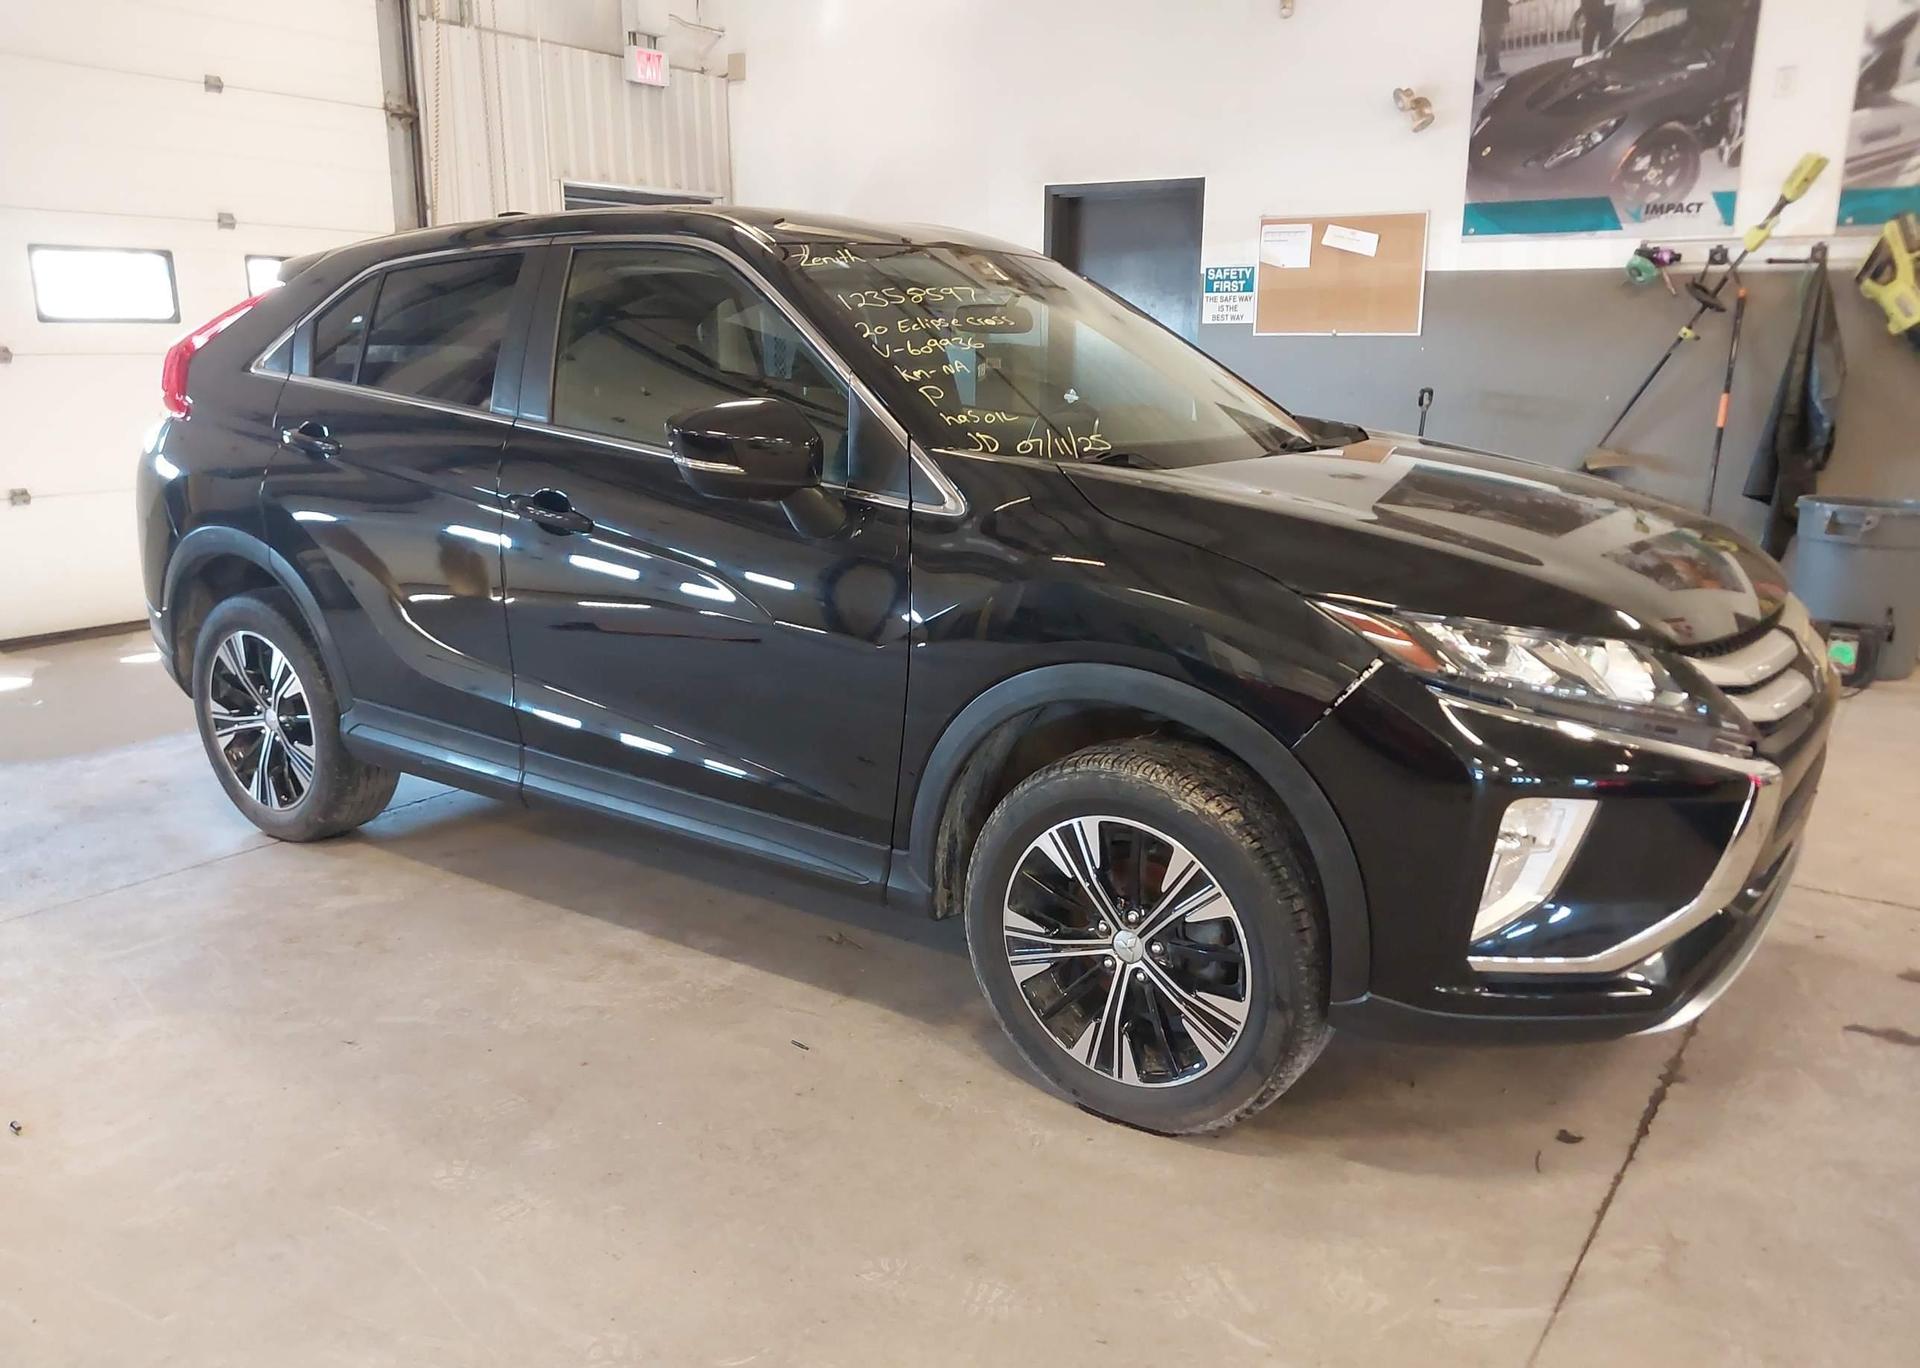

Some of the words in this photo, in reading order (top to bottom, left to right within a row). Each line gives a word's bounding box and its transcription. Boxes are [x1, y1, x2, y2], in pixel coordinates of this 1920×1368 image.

[1645, 203, 1703, 215] IMPACT
[791, 244, 867, 267] Zenith
[1207, 268, 1252, 280] SAFETY
[1213, 280, 1246, 292] FIRST
[837, 287, 976, 311] 12358597
[855, 321, 888, 339] 20
[897, 317, 963, 332] Eclipse
[918, 385, 944, 407] P
[966, 432, 1000, 453] JD
[1016, 425, 1112, 459] 07/11/25
